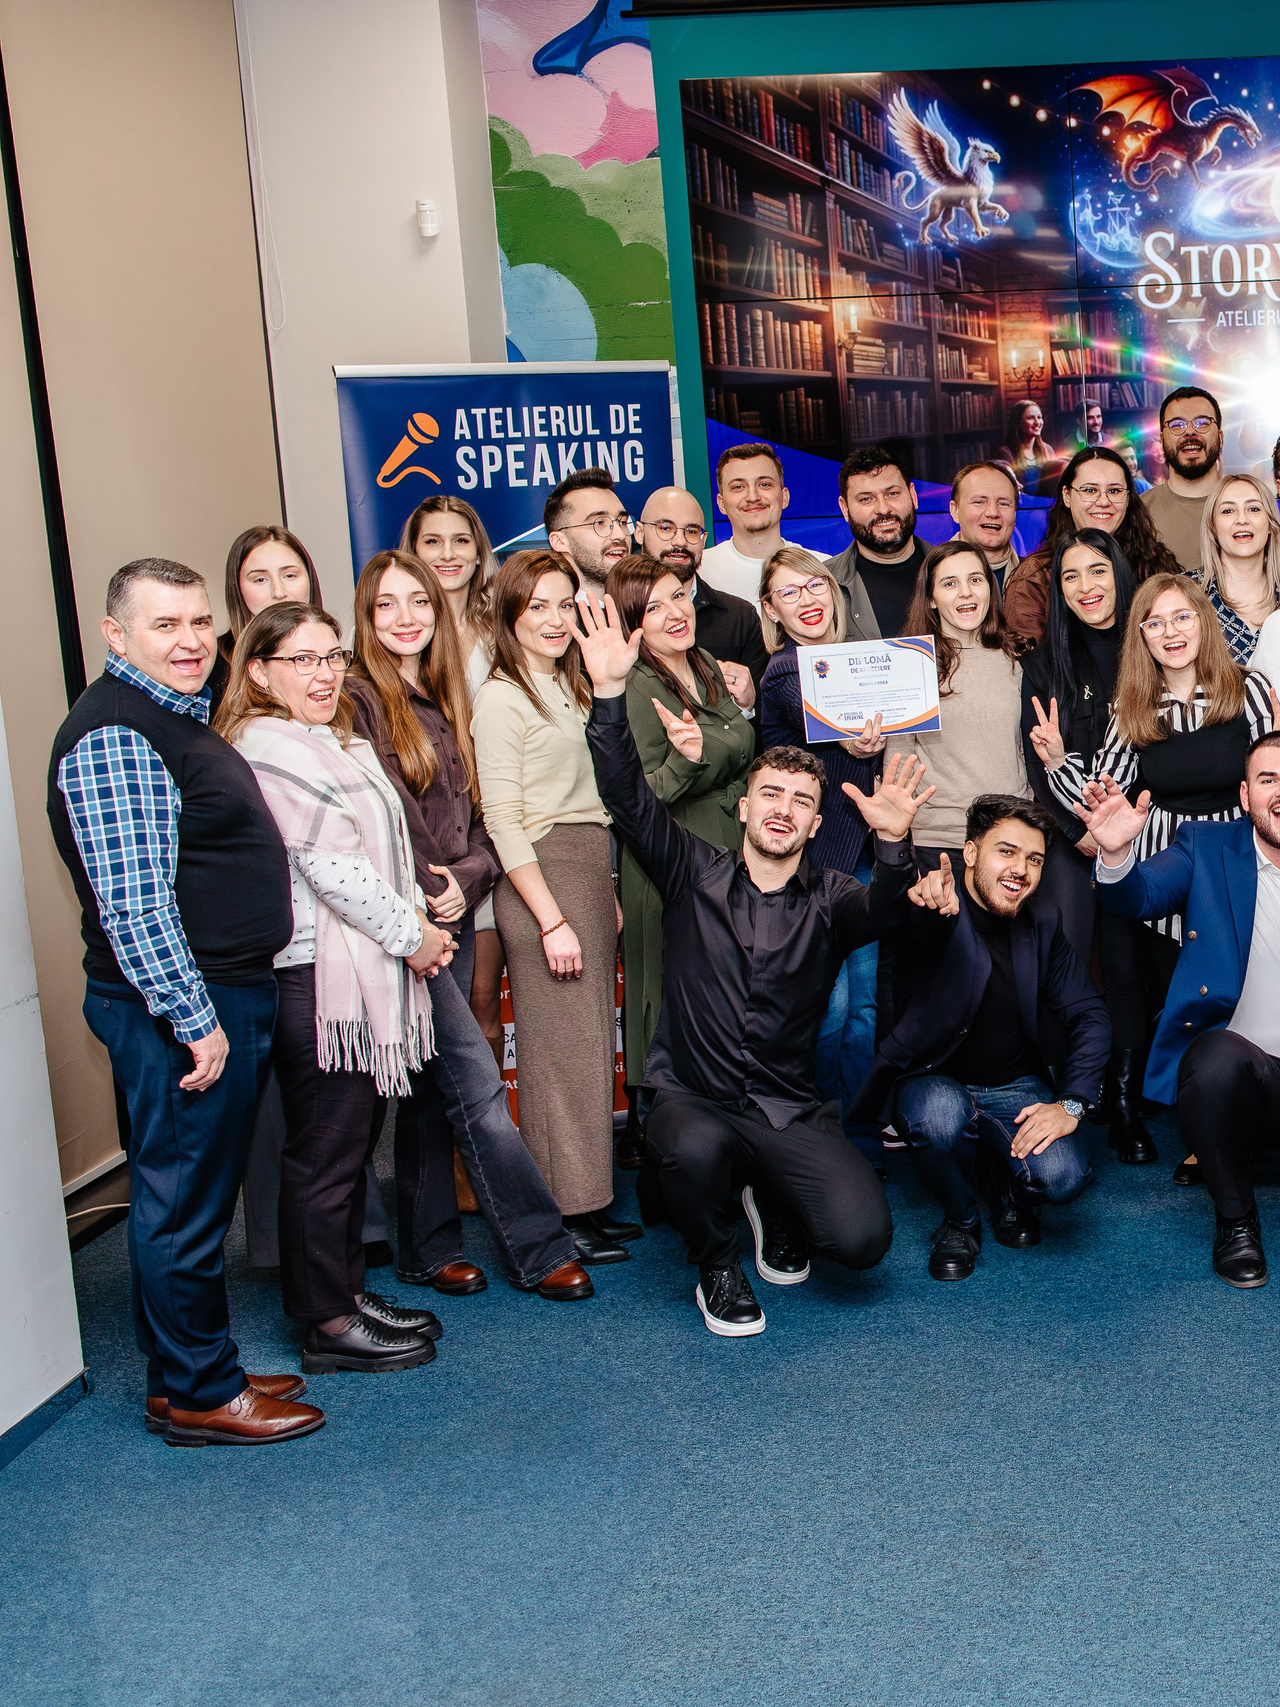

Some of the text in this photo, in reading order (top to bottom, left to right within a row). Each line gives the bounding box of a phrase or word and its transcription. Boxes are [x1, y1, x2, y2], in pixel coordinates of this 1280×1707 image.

[454, 403, 643, 440] ATELIERUL DE
[455, 440, 645, 490] SPEAKING
[859, 664, 892, 673] ACIERE
